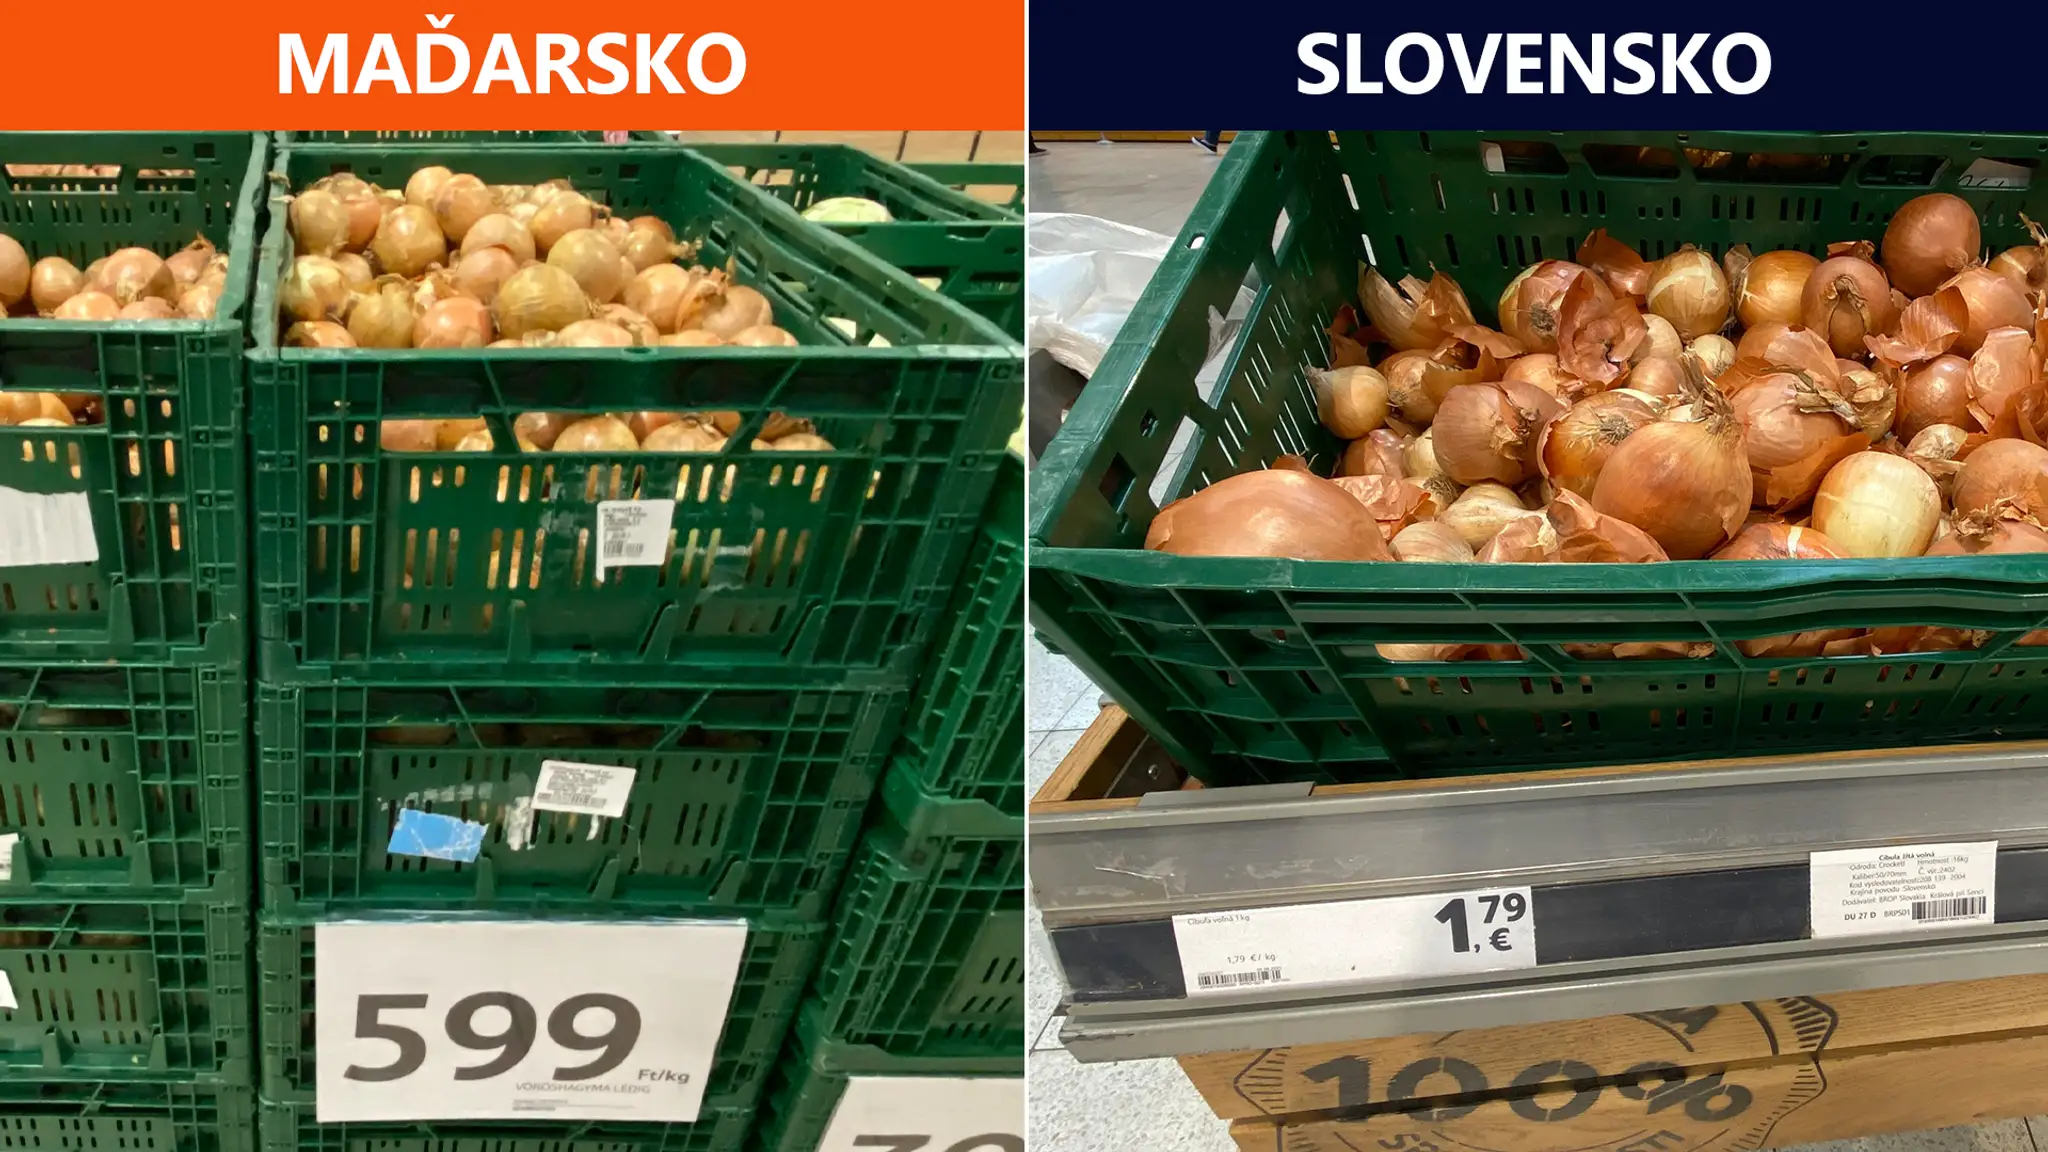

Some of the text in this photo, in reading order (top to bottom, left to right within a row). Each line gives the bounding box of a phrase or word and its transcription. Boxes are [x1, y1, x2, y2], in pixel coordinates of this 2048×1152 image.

[1844, 913, 1856, 921] DU
[1858, 912, 1868, 920] 27
[1869, 911, 1877, 919] D
[1488, 927, 1513, 952] €
[1227, 954, 1246, 965] 1,79
[1264, 952, 1277, 962] kg
[343, 990, 642, 1083] 599
[637, 1068, 690, 1085] Ft/kg
[1303, 1055, 1753, 1122] 100%
